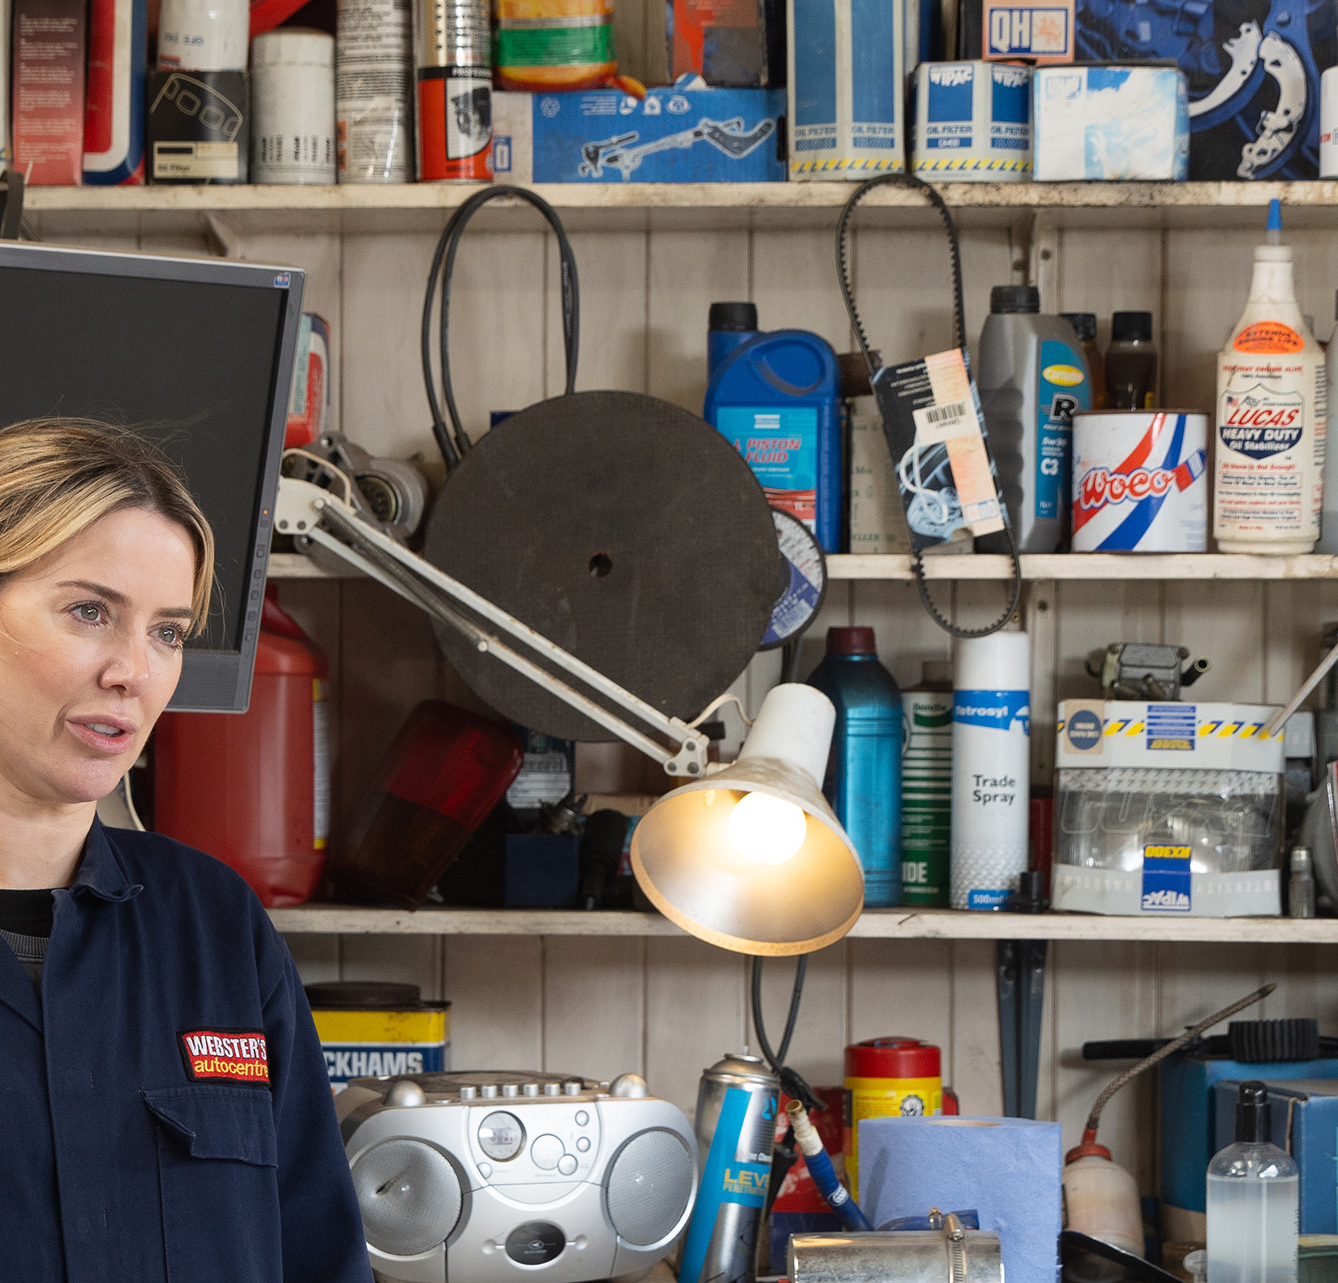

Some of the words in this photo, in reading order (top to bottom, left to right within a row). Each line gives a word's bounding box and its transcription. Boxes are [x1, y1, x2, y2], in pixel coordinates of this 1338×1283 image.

[991, 9, 1031, 53] QH
[930, 69, 973, 87] WIPAC
[1226, 408, 1300, 427] LUCAS
[1221, 429, 1262, 441] HEAVY
[1264, 429, 1300, 441] DUTY
[746, 438, 801, 451] PISTON
[1229, 441, 1243, 451] Oil
[745, 451, 789, 464] FLUID
[1040, 458, 1059, 476] C3
[955, 704, 1009, 719] Tetrosyl
[972, 773, 1016, 789] Trade
[972, 788, 1016, 806] Spray
[902, 861, 928, 884] IDE
[1143, 890, 1189, 907] WIPAC
[185, 1034, 267, 1062] WEBSTER'S
[323, 1051, 423, 1077] CKHAMS
